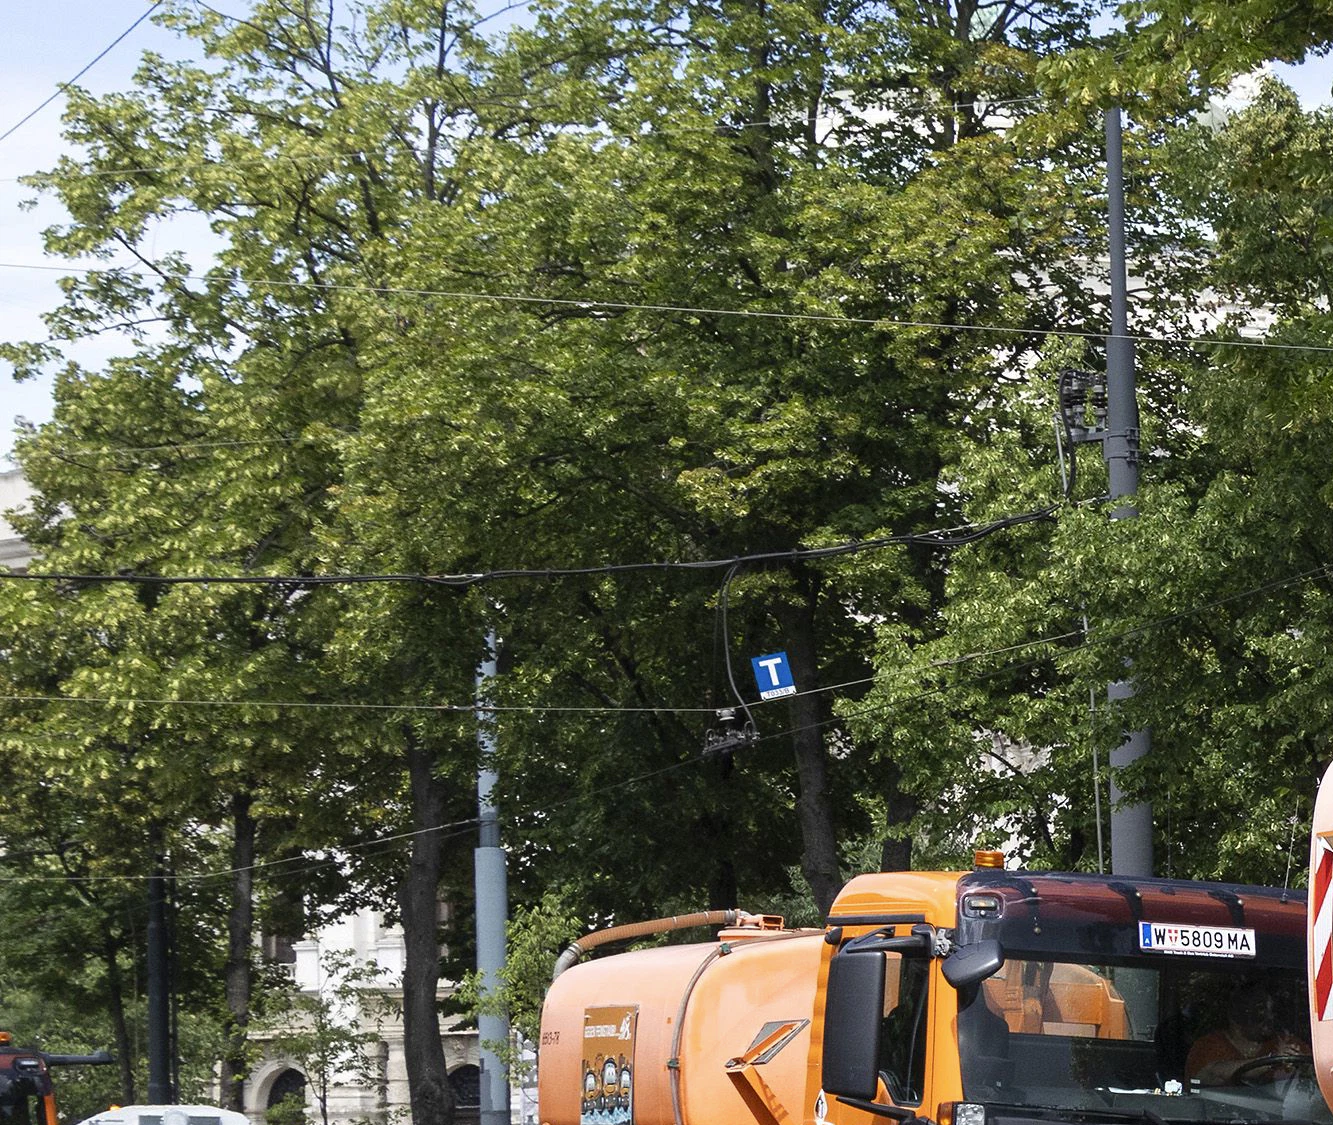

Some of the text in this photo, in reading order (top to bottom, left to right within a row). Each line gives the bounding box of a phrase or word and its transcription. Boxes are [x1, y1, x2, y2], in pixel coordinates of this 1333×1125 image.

[758, 657, 782, 686] T
[1154, 928, 1166, 945] W
[1180, 929, 1224, 949] 5809
[1227, 932, 1251, 951] MA
